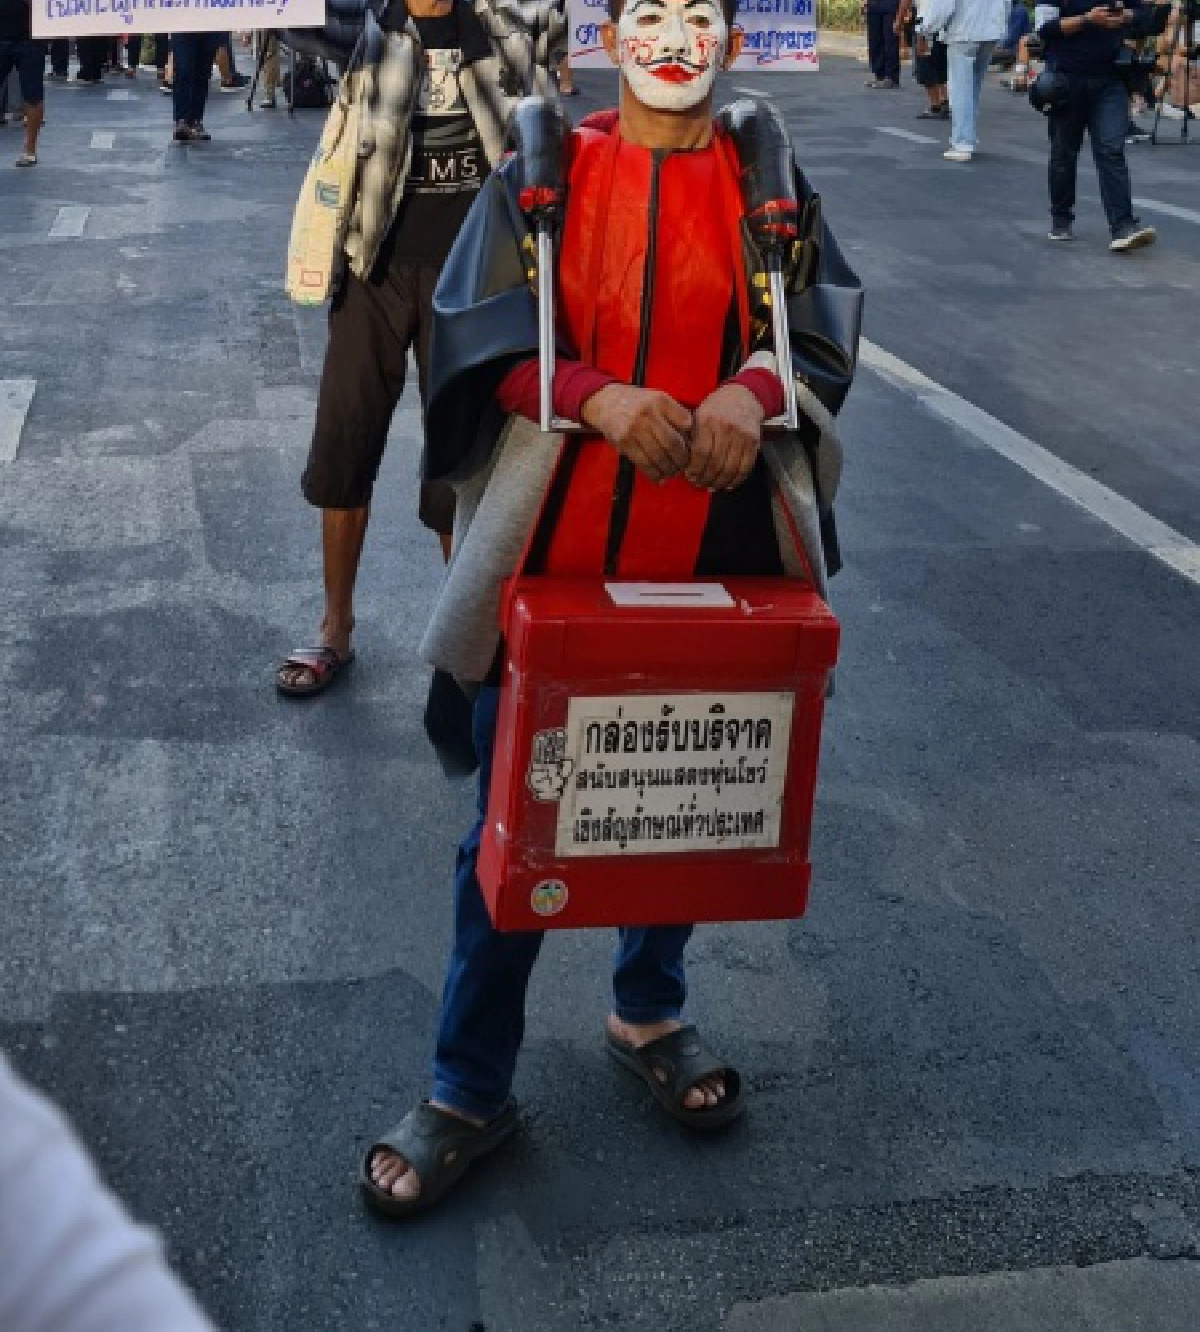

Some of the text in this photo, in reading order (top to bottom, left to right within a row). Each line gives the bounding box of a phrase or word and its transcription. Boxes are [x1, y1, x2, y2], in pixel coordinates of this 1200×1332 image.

[586, 702, 773, 754] กล่องรับบริจาค
[575, 755, 769, 799] สนับสนุนแสดงหุ่นโชว์
[572, 792, 766, 849] เชิงสัญลักษณ์ทั่วประเทศ
